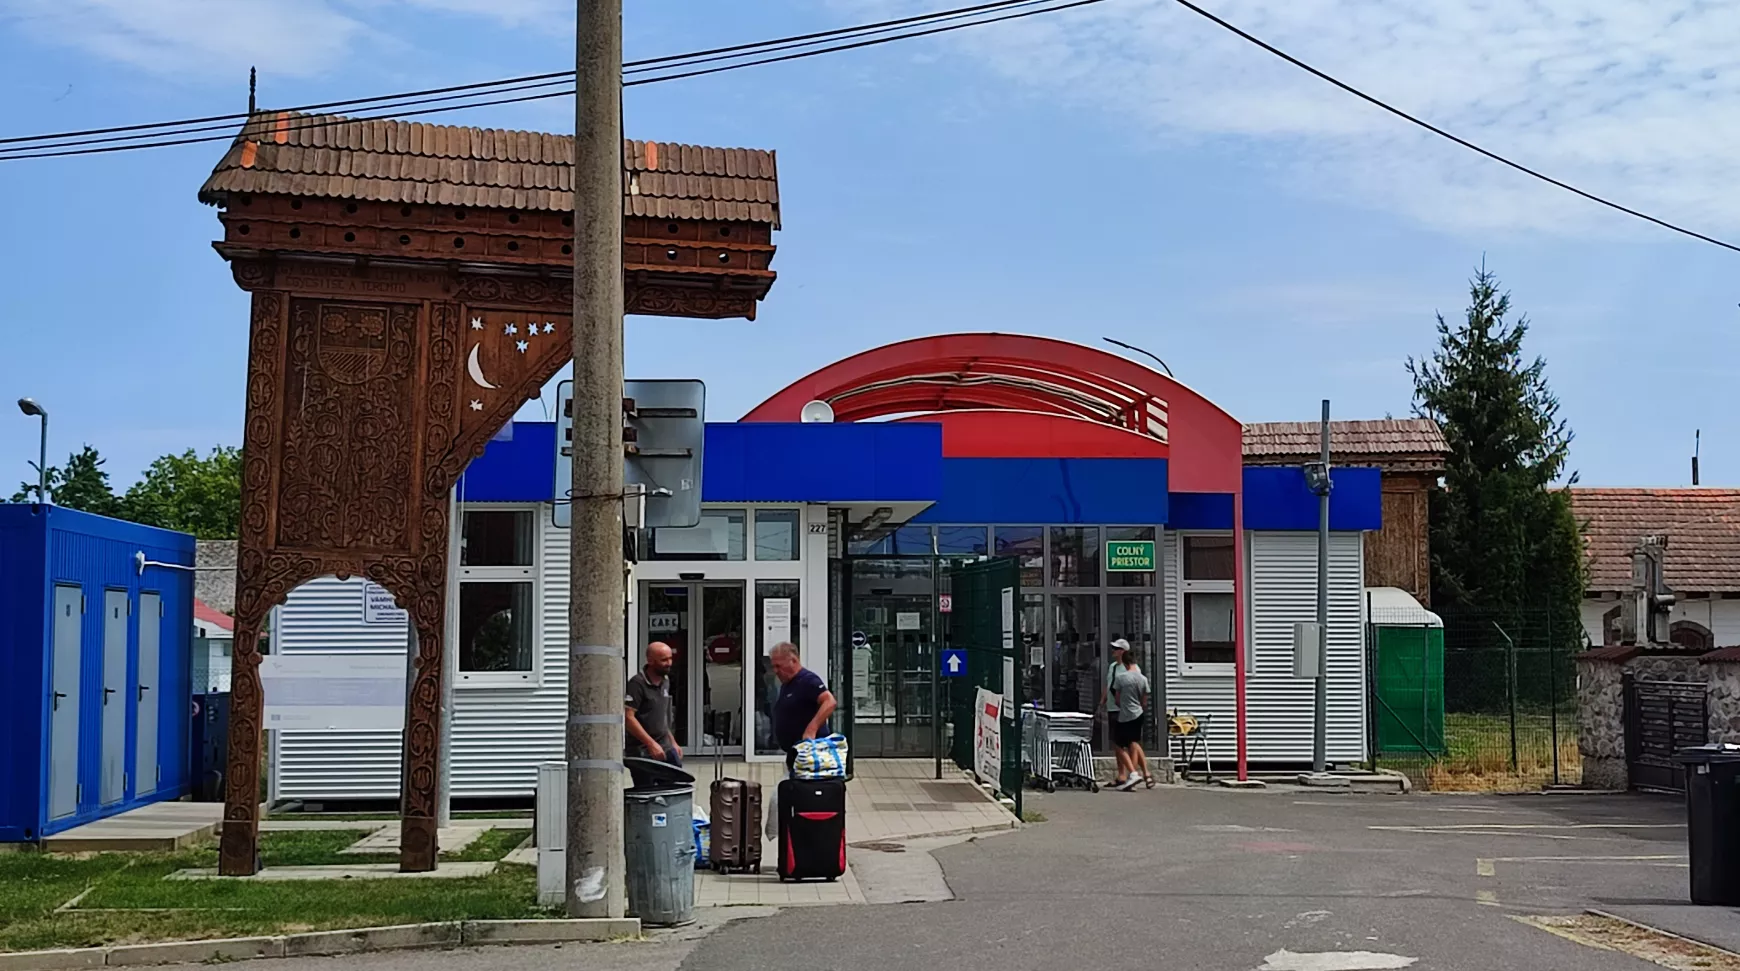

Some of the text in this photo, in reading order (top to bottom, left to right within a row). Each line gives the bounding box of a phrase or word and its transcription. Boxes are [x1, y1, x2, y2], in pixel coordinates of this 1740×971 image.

[810, 524, 826, 534] 227
[1116, 544, 1145, 556] COLNÝ
[1111, 557, 1150, 566] PRIESTOR
